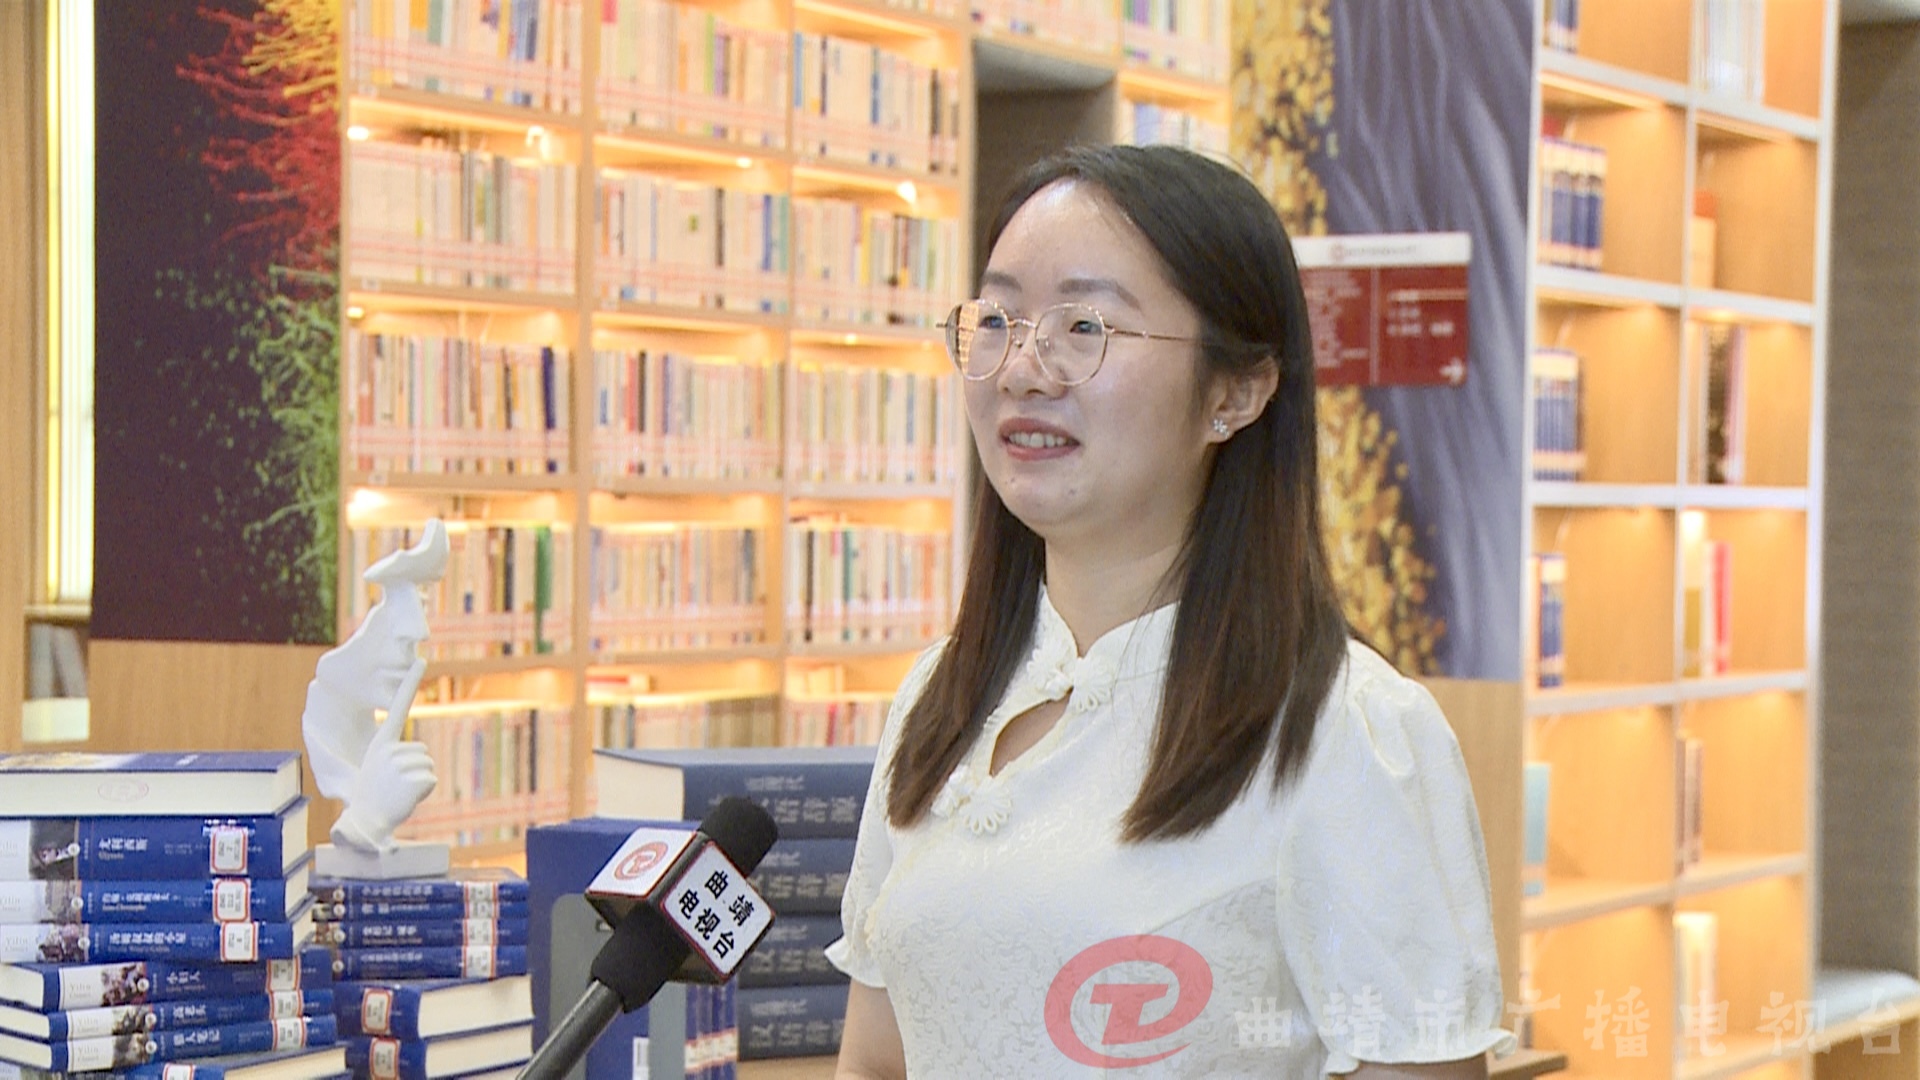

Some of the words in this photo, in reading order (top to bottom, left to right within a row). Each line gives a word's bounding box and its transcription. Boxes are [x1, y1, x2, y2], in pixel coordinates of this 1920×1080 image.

[679, 889, 734, 959] 电视台
[704, 871, 754, 926] 曲靖
